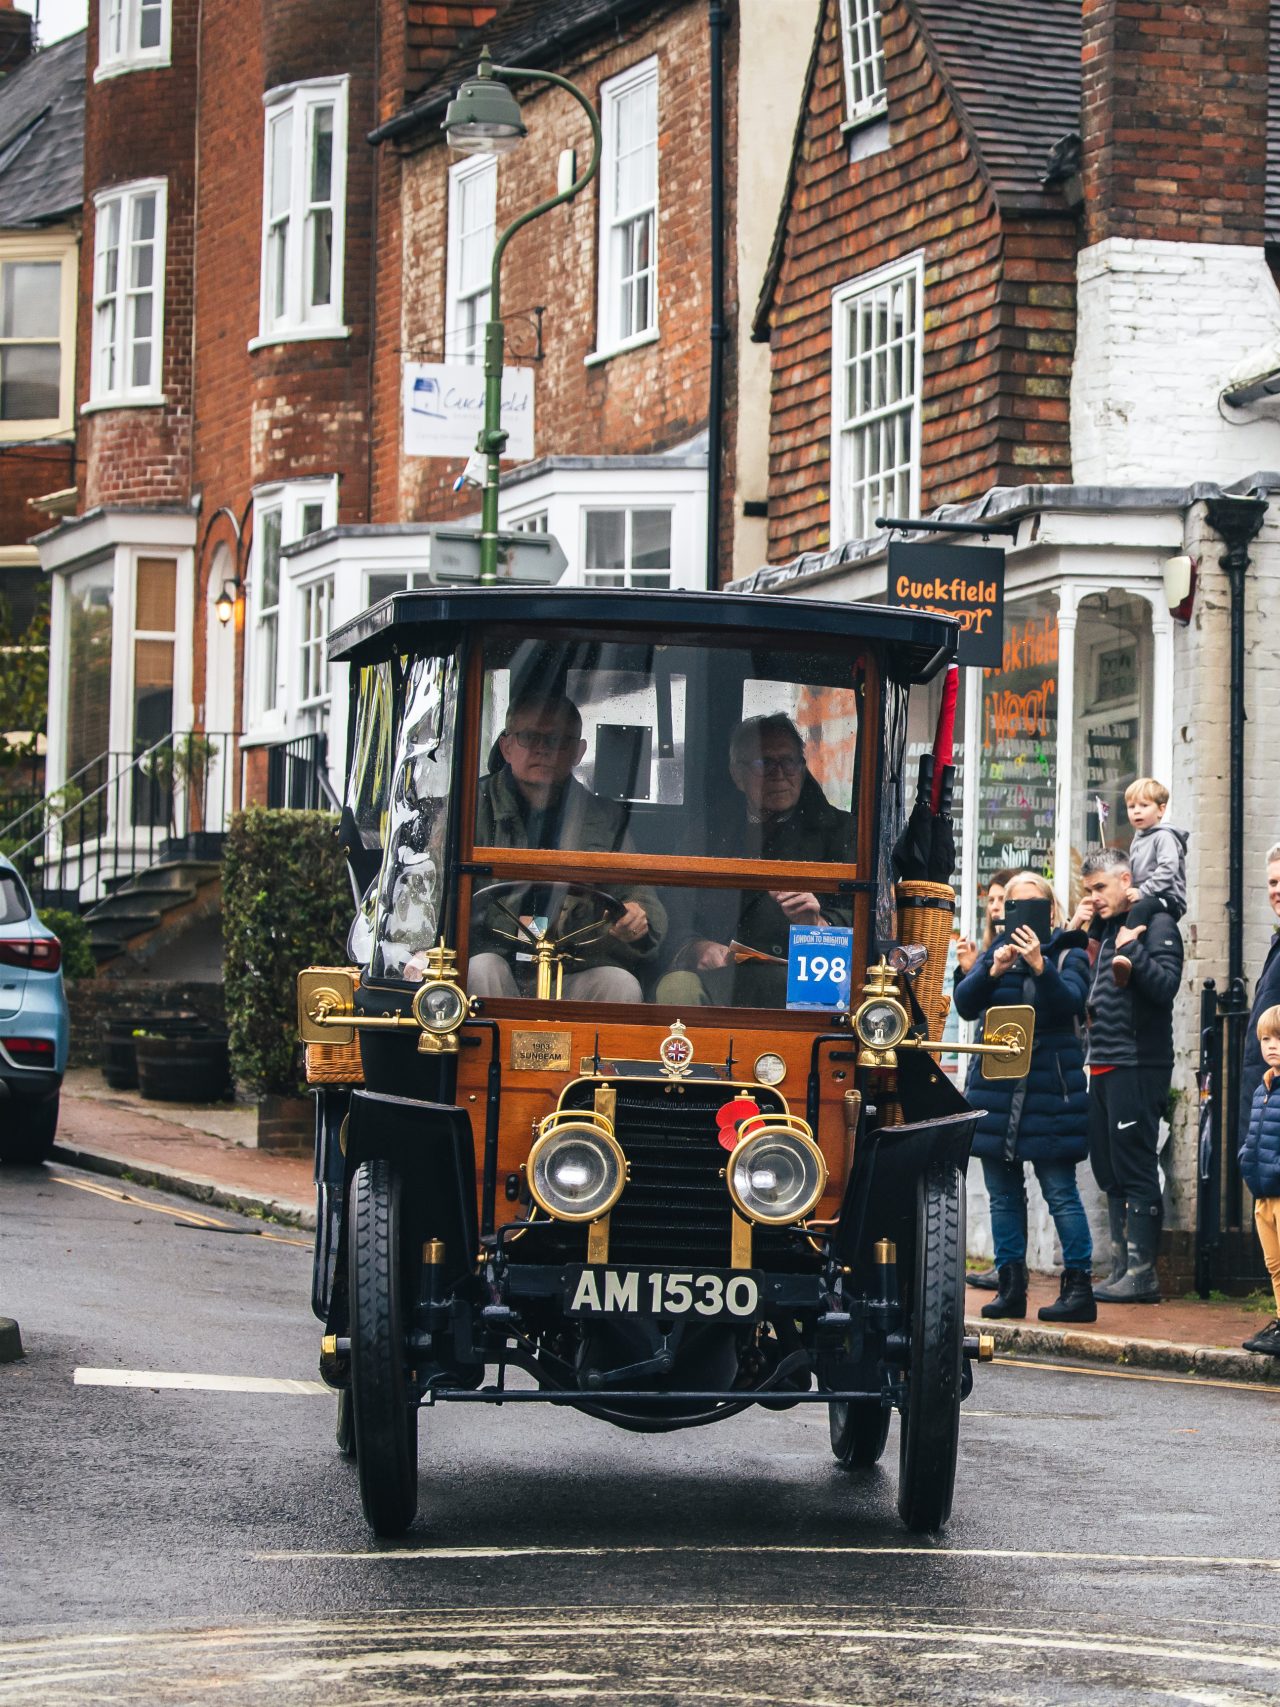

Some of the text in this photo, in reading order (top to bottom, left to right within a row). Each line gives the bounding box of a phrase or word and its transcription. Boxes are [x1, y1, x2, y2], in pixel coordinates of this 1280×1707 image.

[896, 575, 997, 604] Cuckfield
[983, 612, 1058, 678] ckfield
[1001, 843, 1030, 868] Show
[793, 934, 815, 945] LONDON
[815, 935, 822, 944] TO
[823, 935, 849, 947] BRIGHTON
[797, 956, 847, 983] 198
[520, 1052, 562, 1060] SUNBEAM
[570, 1270, 758, 1316] AM 1530
